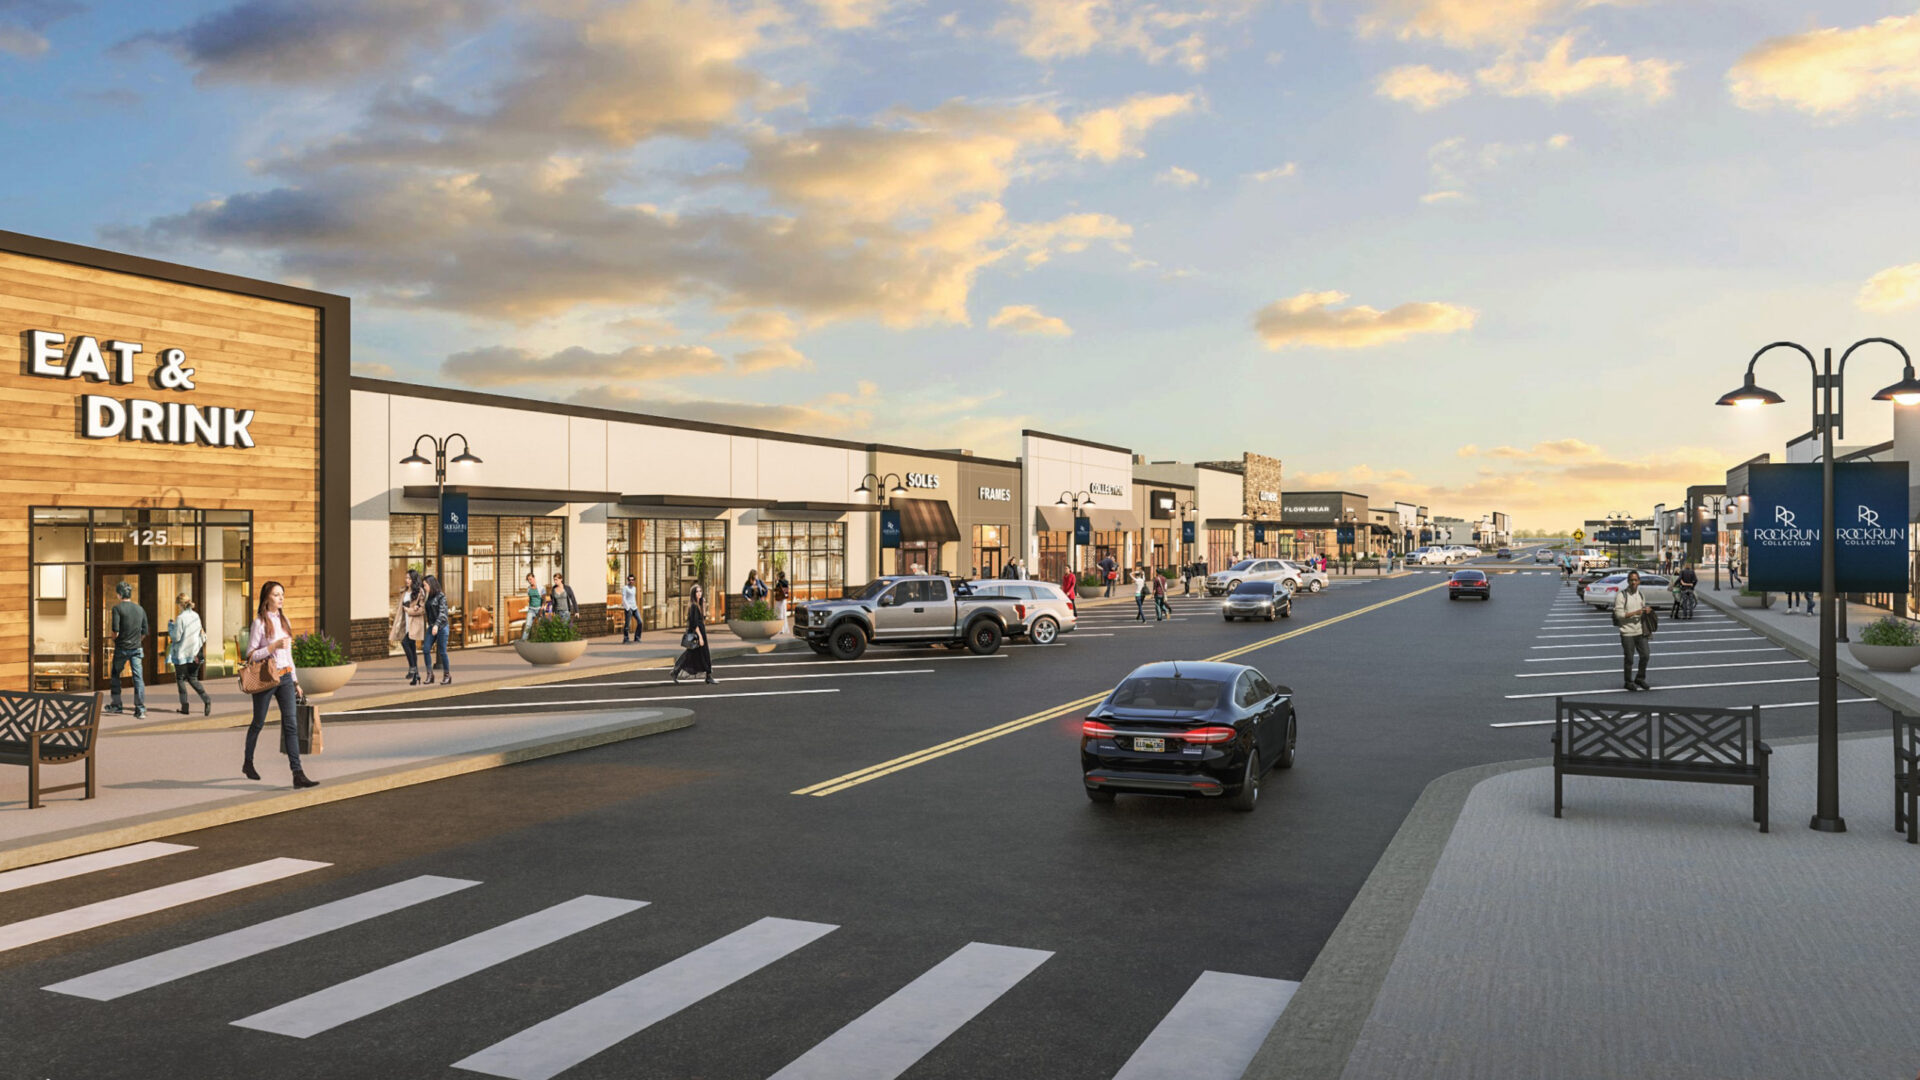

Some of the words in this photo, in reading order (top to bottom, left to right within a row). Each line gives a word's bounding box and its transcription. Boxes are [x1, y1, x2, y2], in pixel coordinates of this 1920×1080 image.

[28, 329, 143, 384] EAT
[157, 348, 195, 390] &
[83, 394, 255, 448] DRINK
[907, 472, 940, 489] SOLES
[979, 486, 1011, 501] FRAMES
[129, 530, 167, 545] 125
[1754, 528, 1820, 541] ROCKRUN
[1836, 528, 1904, 540] ROCKRUN
